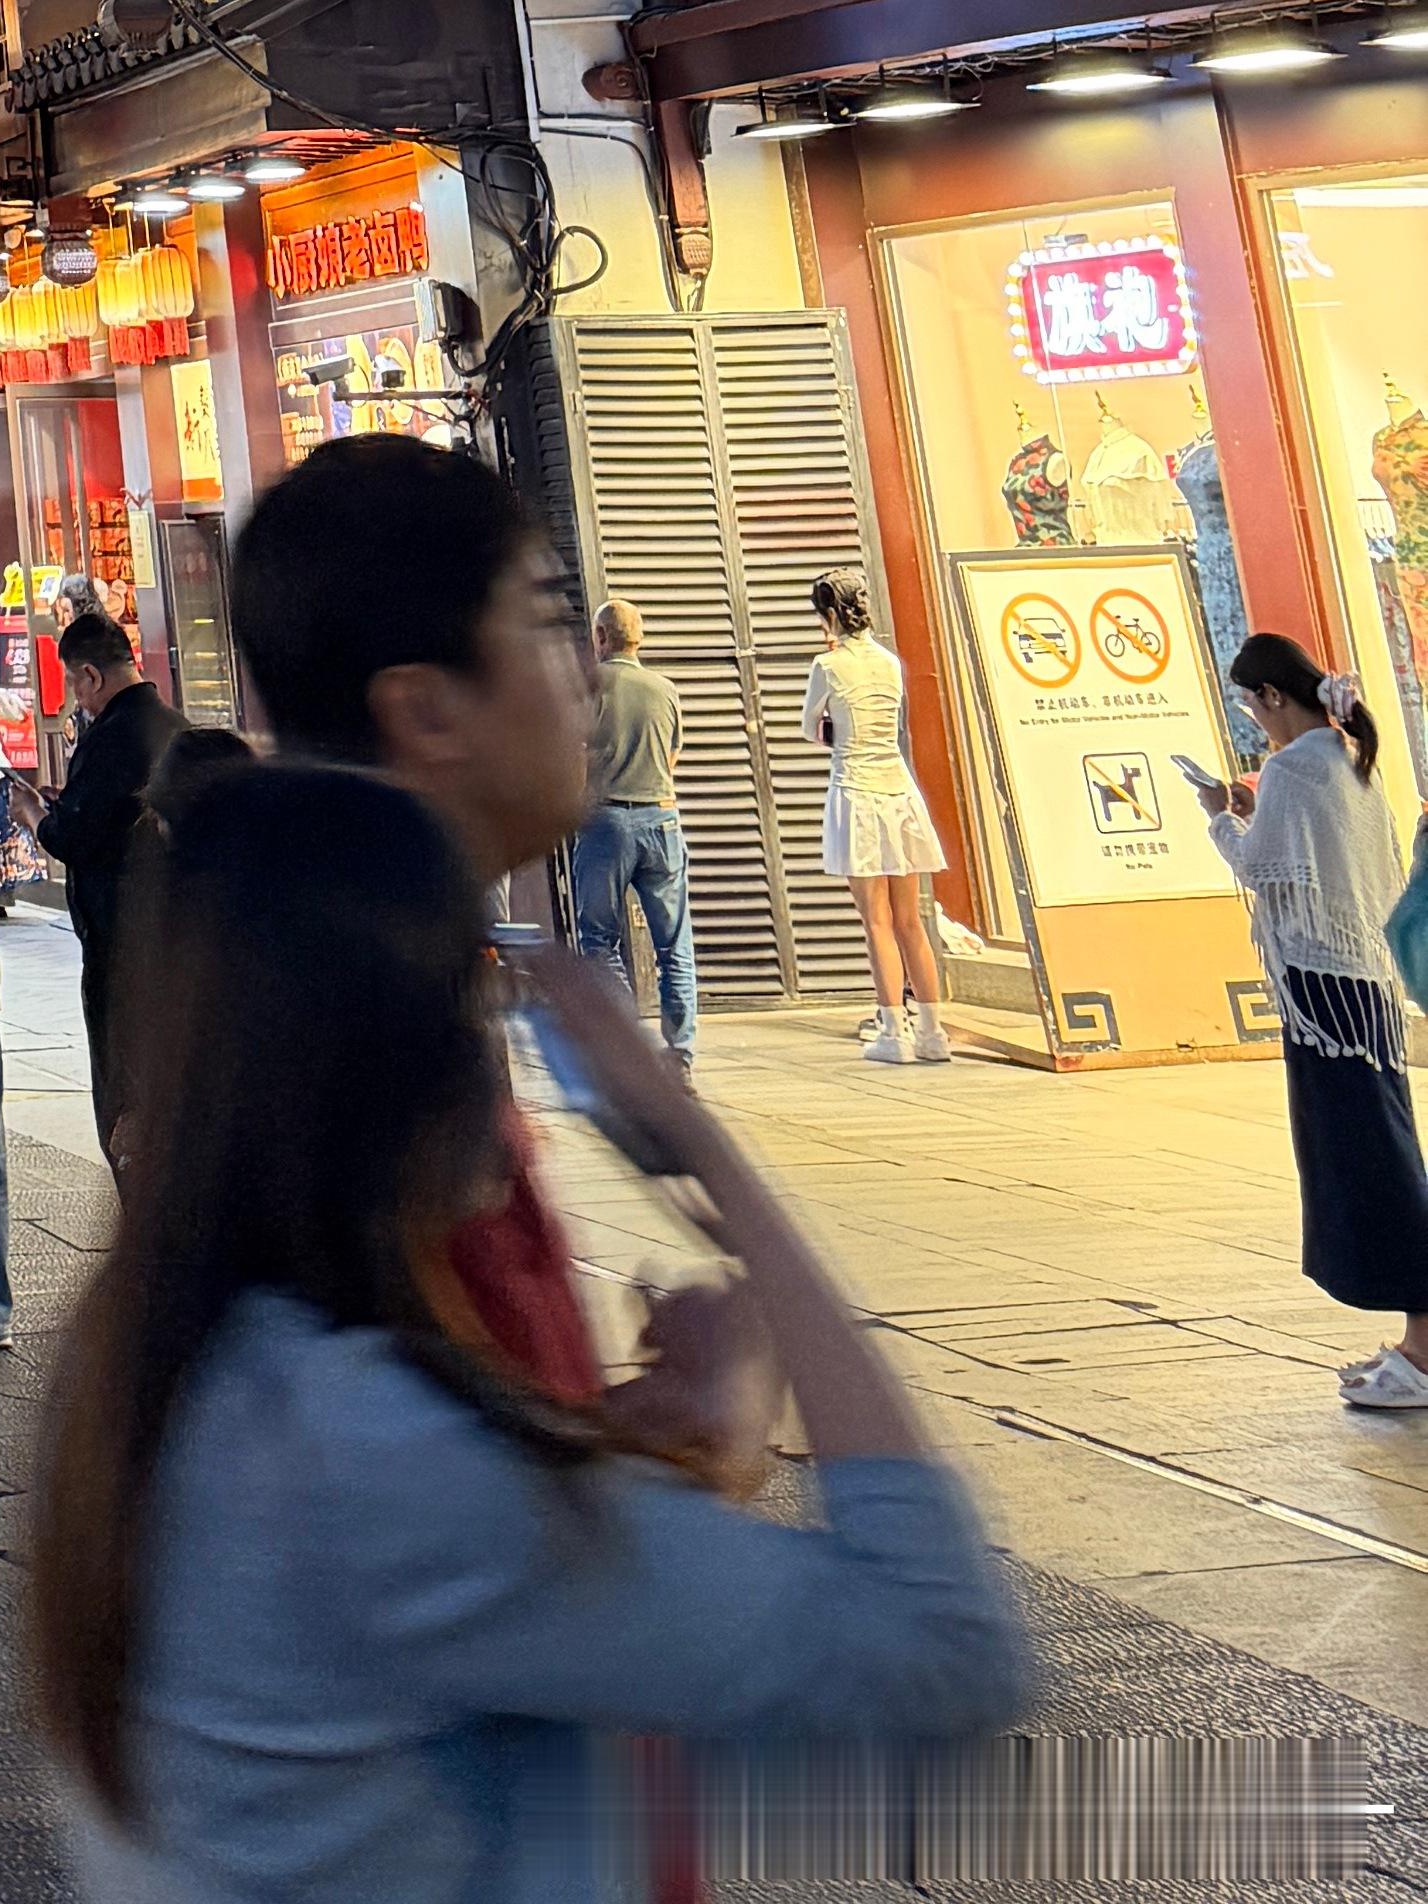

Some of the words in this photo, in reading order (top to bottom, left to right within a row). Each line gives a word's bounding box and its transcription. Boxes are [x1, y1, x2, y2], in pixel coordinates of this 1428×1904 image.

[266, 201, 430, 300] 小厨娘老卤鸭
[1043, 265, 1170, 357] 旗袍
